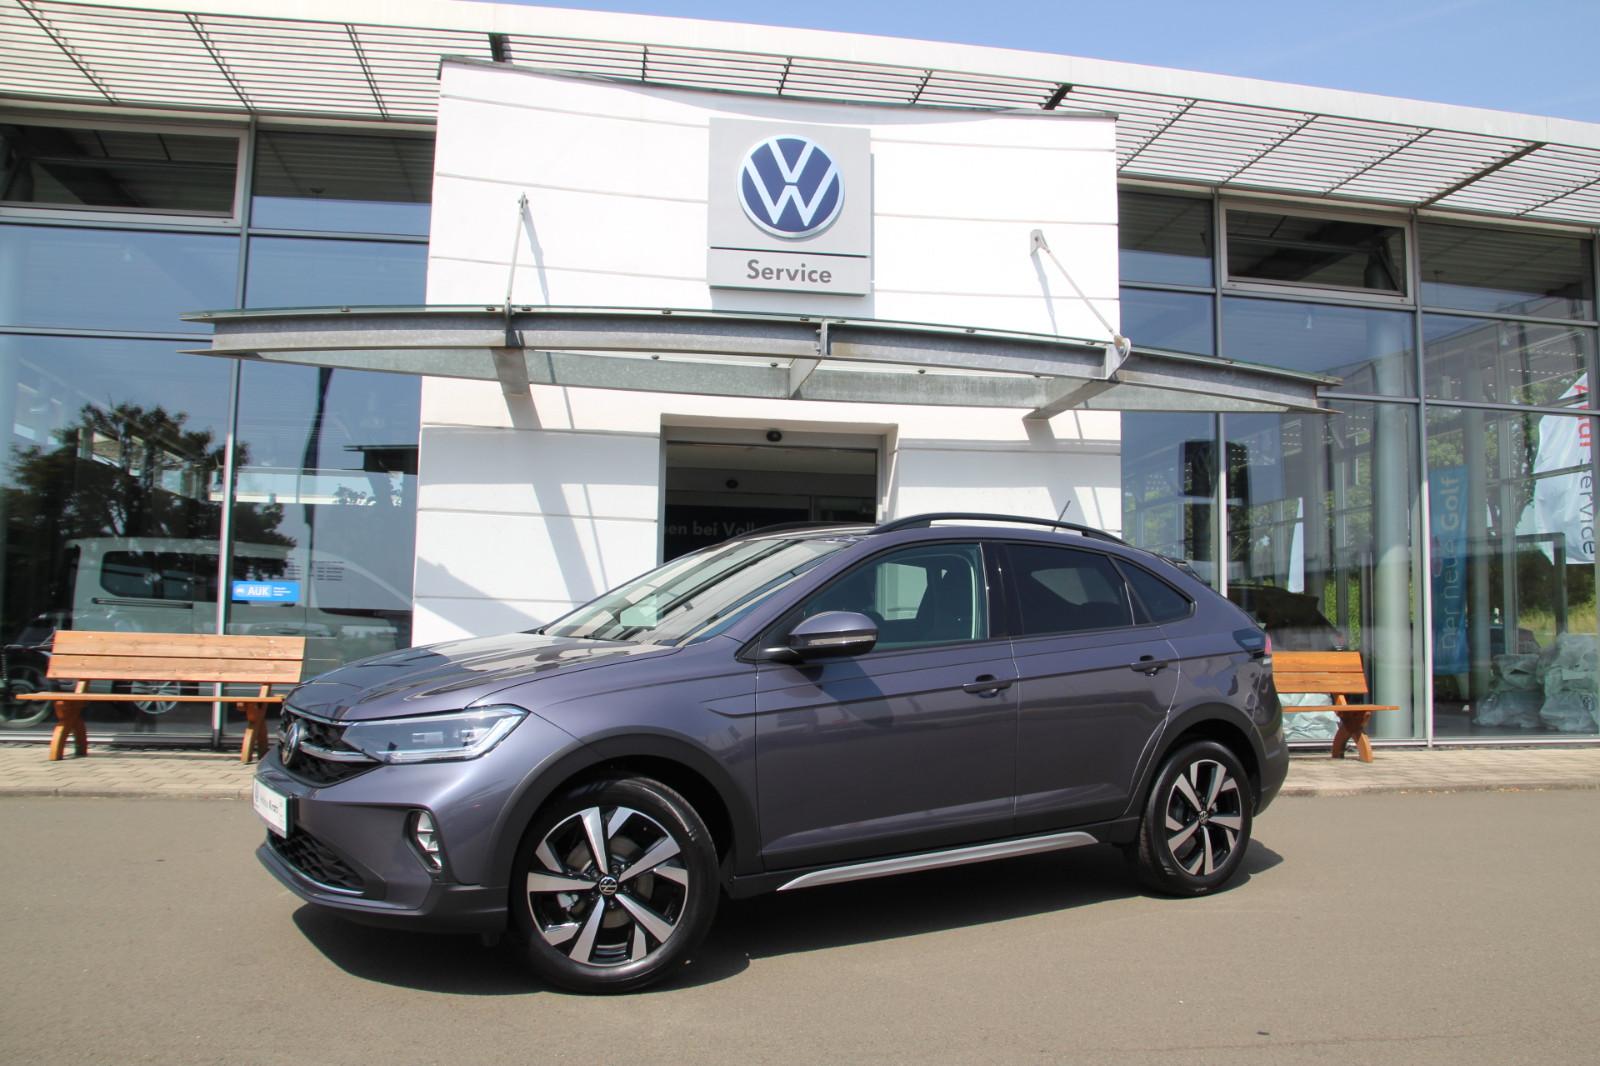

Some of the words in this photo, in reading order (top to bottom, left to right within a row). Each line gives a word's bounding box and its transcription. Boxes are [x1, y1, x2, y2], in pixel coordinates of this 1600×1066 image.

[744, 138, 838, 227] VW
[746, 258, 832, 284] Service
[1440, 476, 1459, 530] Golf
[692, 520, 718, 537] bei
